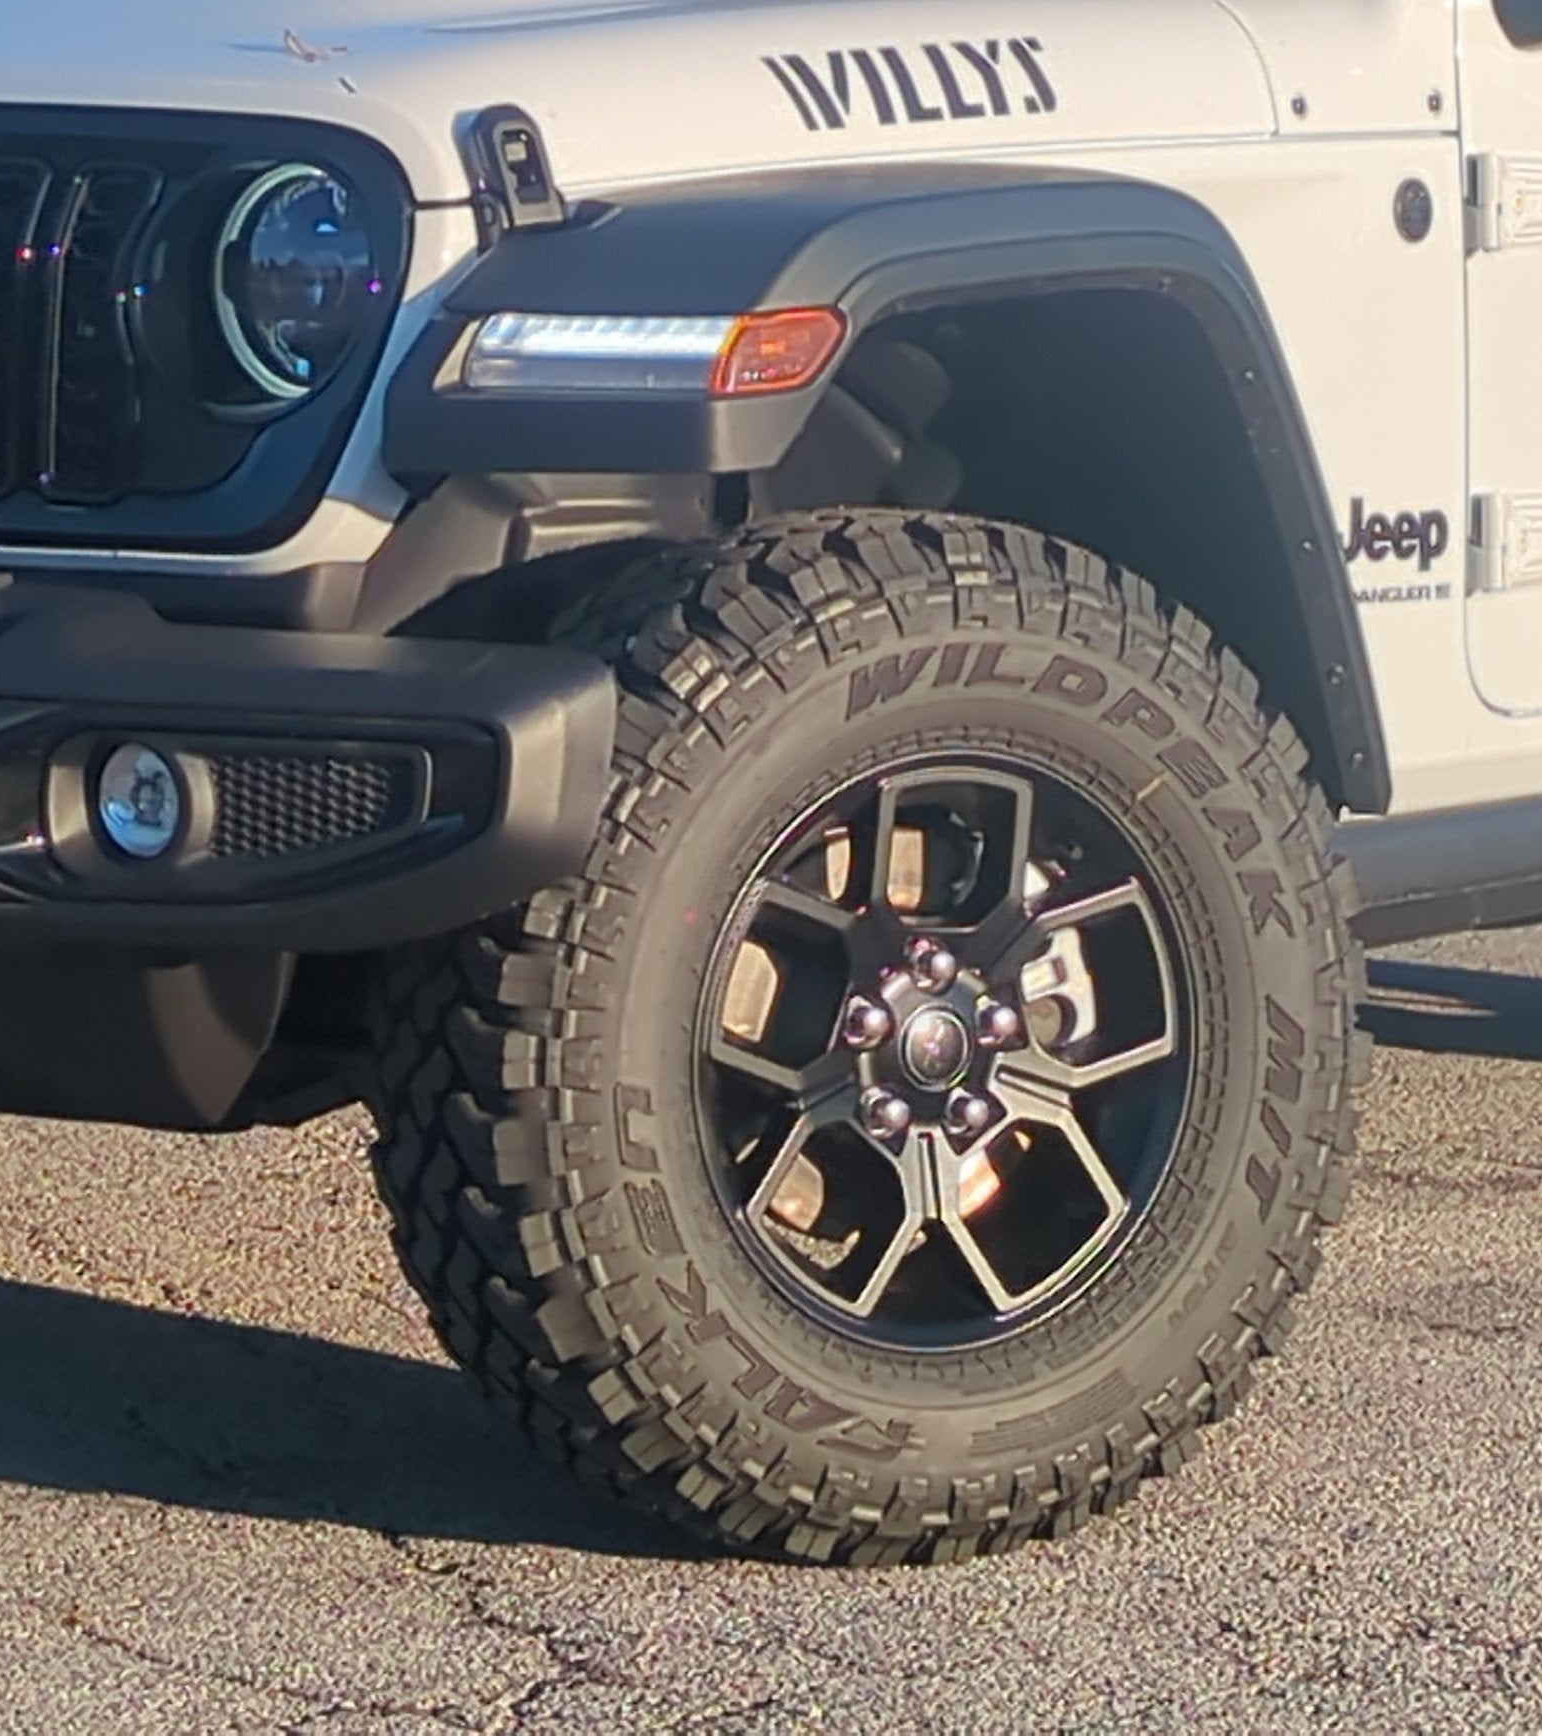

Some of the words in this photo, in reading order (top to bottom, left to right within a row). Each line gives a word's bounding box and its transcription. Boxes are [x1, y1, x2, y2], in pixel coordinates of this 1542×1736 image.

[760, 36, 1058, 132] WILLYS
[1343, 495, 1449, 572] Jeep
[844, 641, 1295, 940] WILDPEAK
